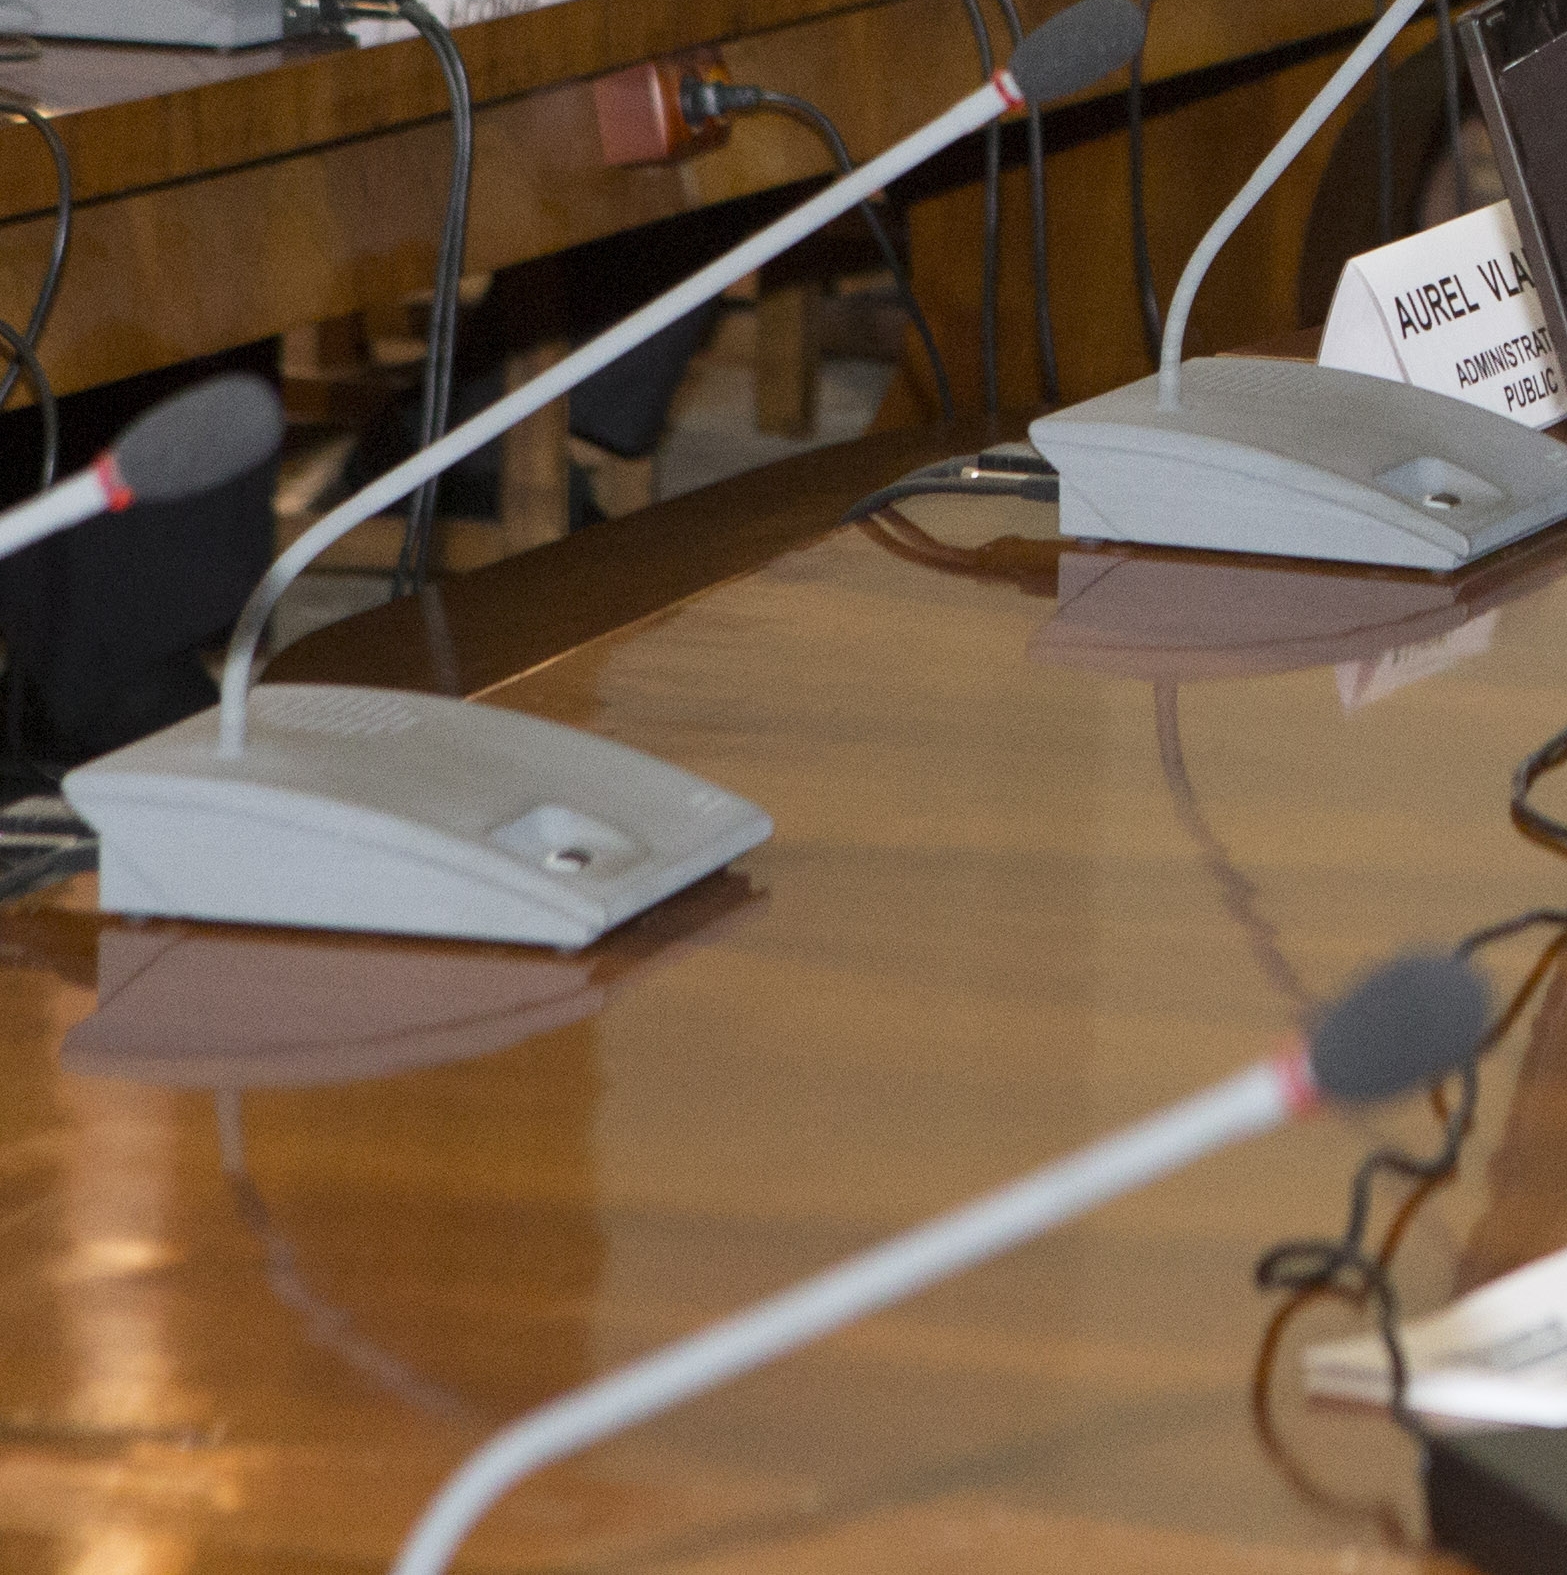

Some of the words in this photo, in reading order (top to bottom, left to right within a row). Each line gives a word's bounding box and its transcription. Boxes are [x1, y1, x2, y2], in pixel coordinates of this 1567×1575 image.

[1394, 274, 1481, 339] AUREL
[1476, 247, 1536, 302] VLA
[1455, 327, 1553, 389] ADMINISTRAT
[1503, 367, 1559, 412] PUBLIC
